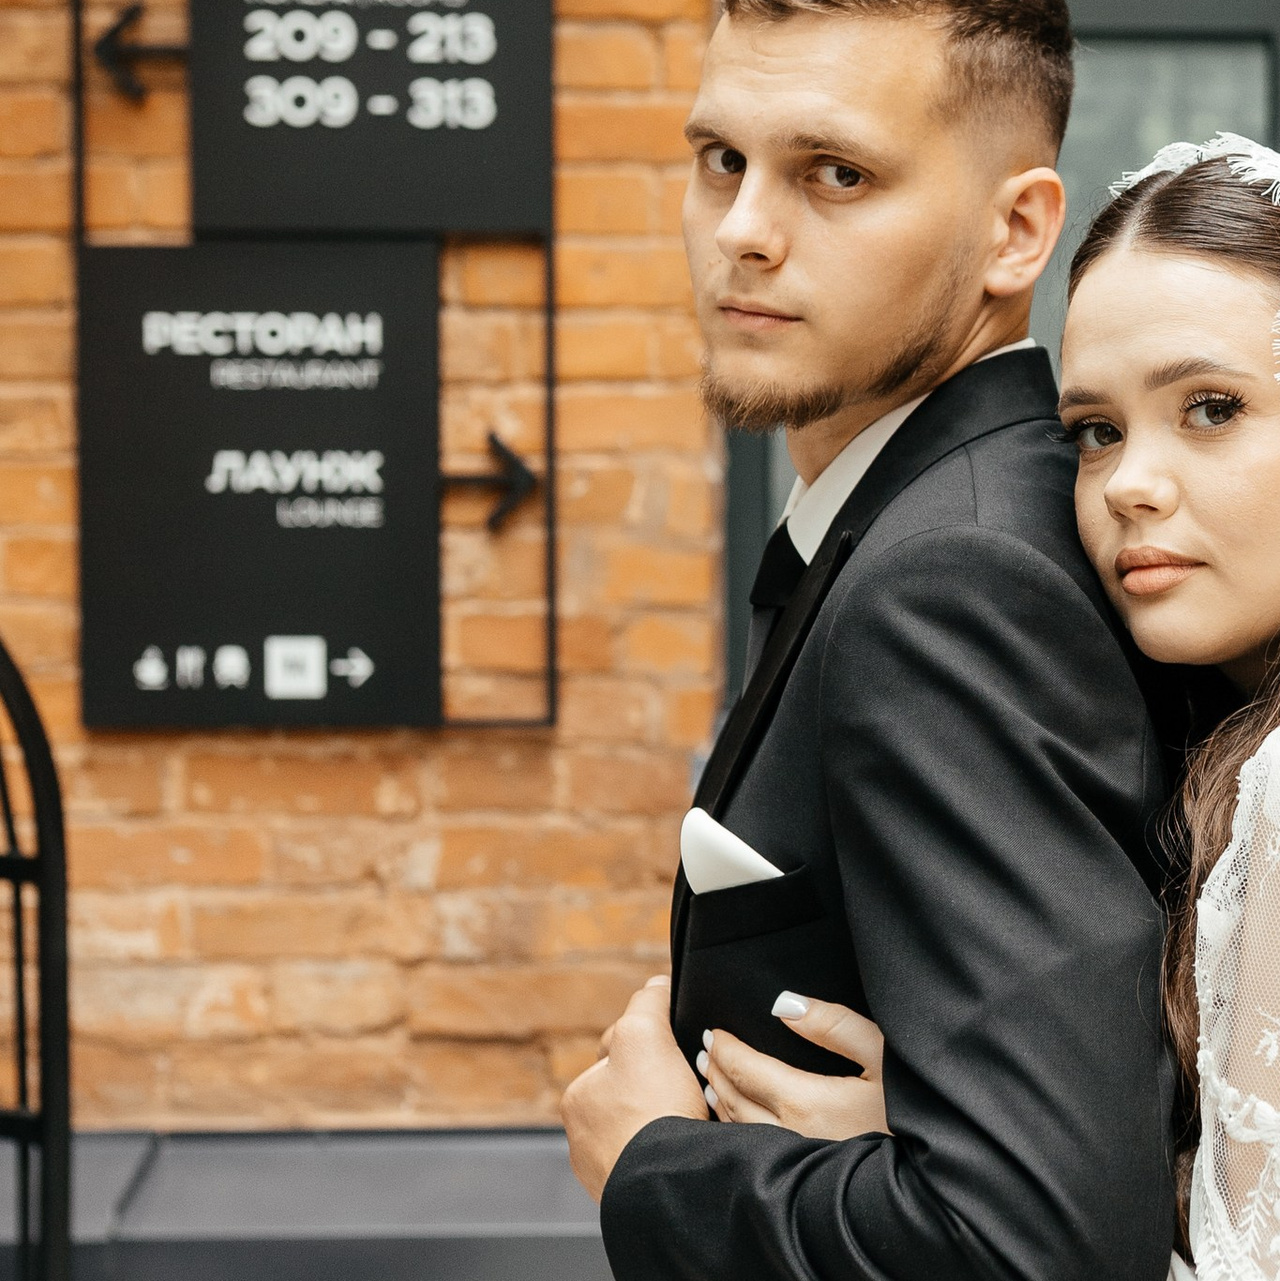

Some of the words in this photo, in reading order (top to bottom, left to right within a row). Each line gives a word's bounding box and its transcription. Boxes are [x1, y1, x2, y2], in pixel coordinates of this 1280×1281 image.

[243, 9, 358, 63] 209
[407, 11, 497, 64] 213
[243, 75, 358, 128] 309
[407, 77, 497, 130] 313
[142, 311, 383, 356] РЕСТОРАН
